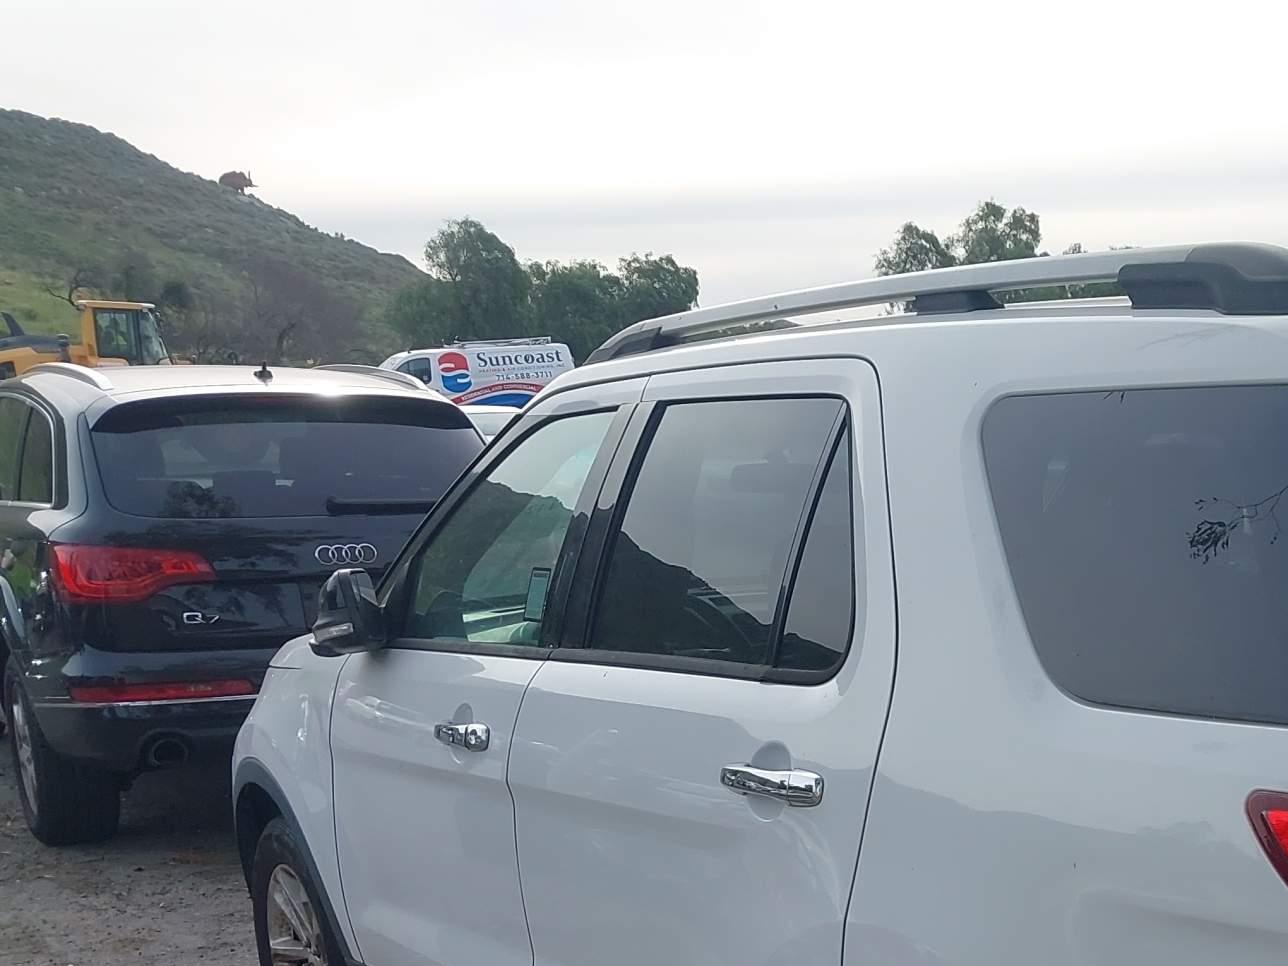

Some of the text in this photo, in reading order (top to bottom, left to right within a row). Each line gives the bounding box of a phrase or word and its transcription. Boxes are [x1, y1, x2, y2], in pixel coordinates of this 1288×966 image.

[476, 350, 563, 368] Suncoast
[496, 371, 552, 381] 714-588-3711
[182, 612, 220, 624] Q7
